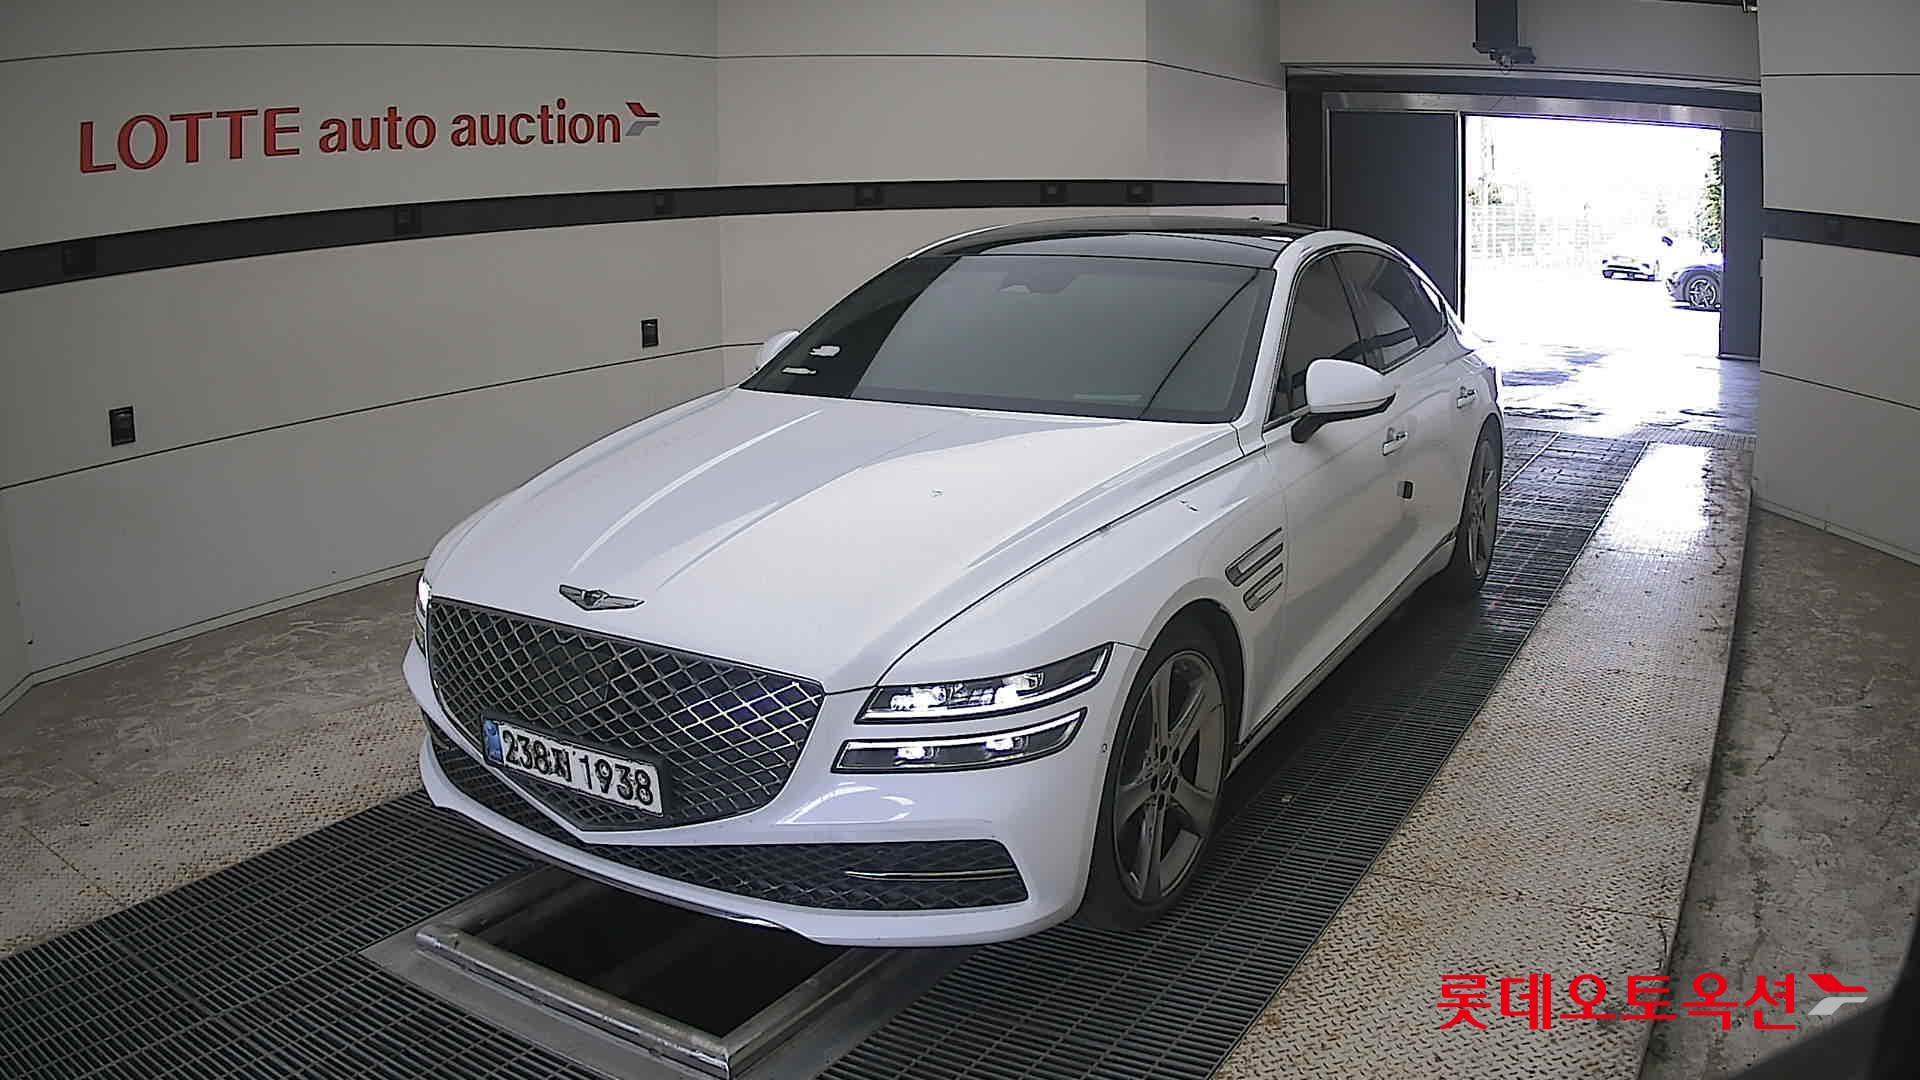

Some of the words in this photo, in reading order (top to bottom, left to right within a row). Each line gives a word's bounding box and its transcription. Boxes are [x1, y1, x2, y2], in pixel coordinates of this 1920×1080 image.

[80, 107, 300, 173] LOTTE
[318, 106, 436, 152] auto
[450, 98, 621, 146] auction
[579, 755, 653, 805] 1938
